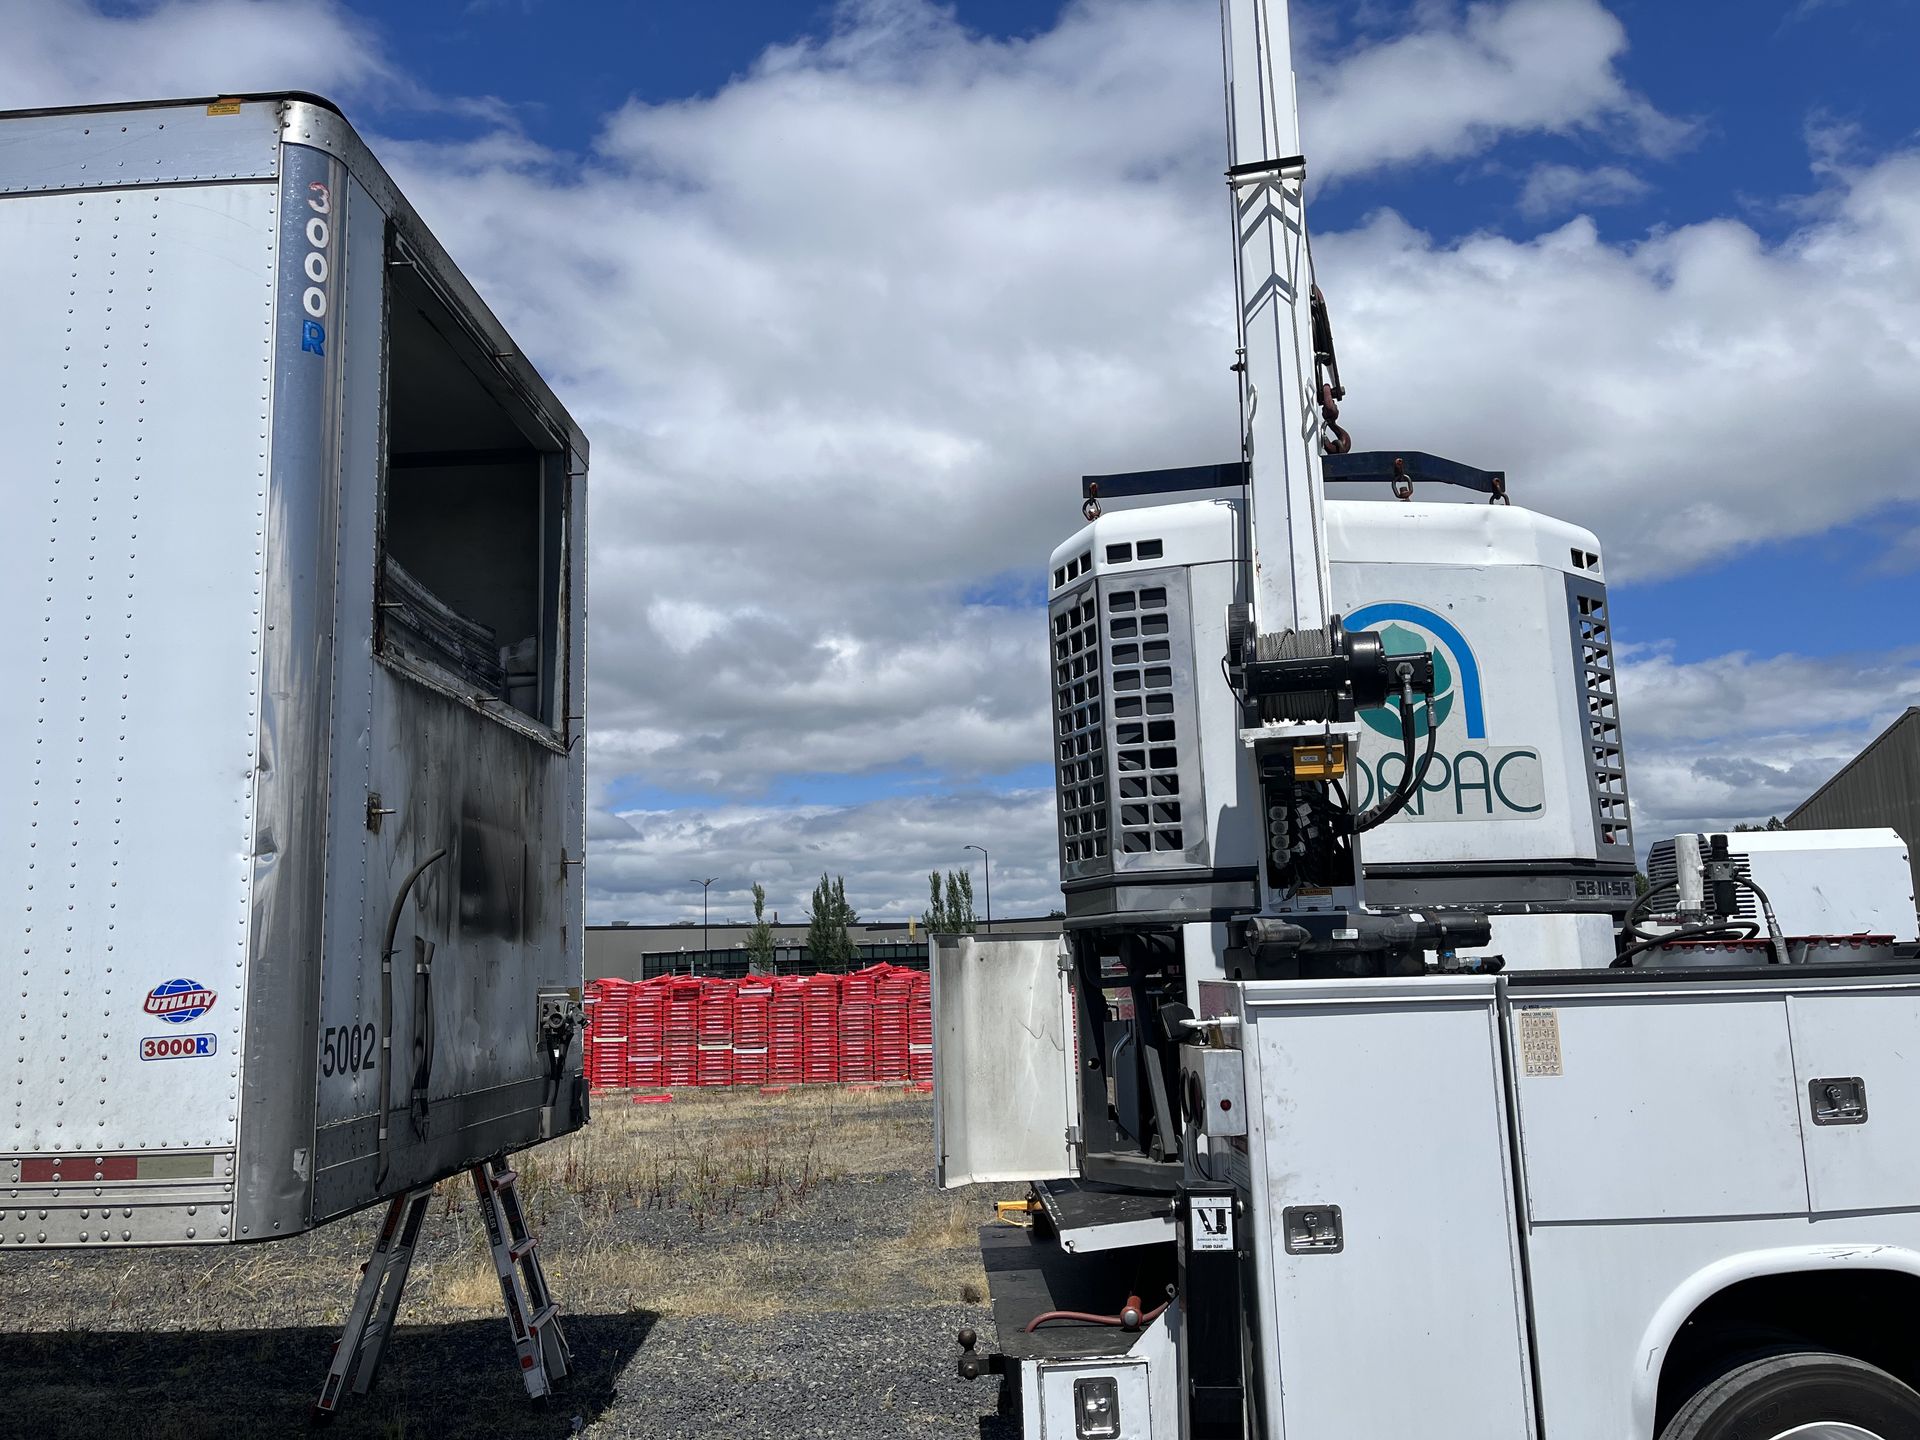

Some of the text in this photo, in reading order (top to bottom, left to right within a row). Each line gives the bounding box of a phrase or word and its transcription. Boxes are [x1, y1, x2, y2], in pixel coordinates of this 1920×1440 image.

[302, 181, 331, 357] 3000R
[147, 991, 216, 1011] UTILITY
[322, 1022, 376, 1078] 5002
[483, 1198, 497, 1229] LEVELER
